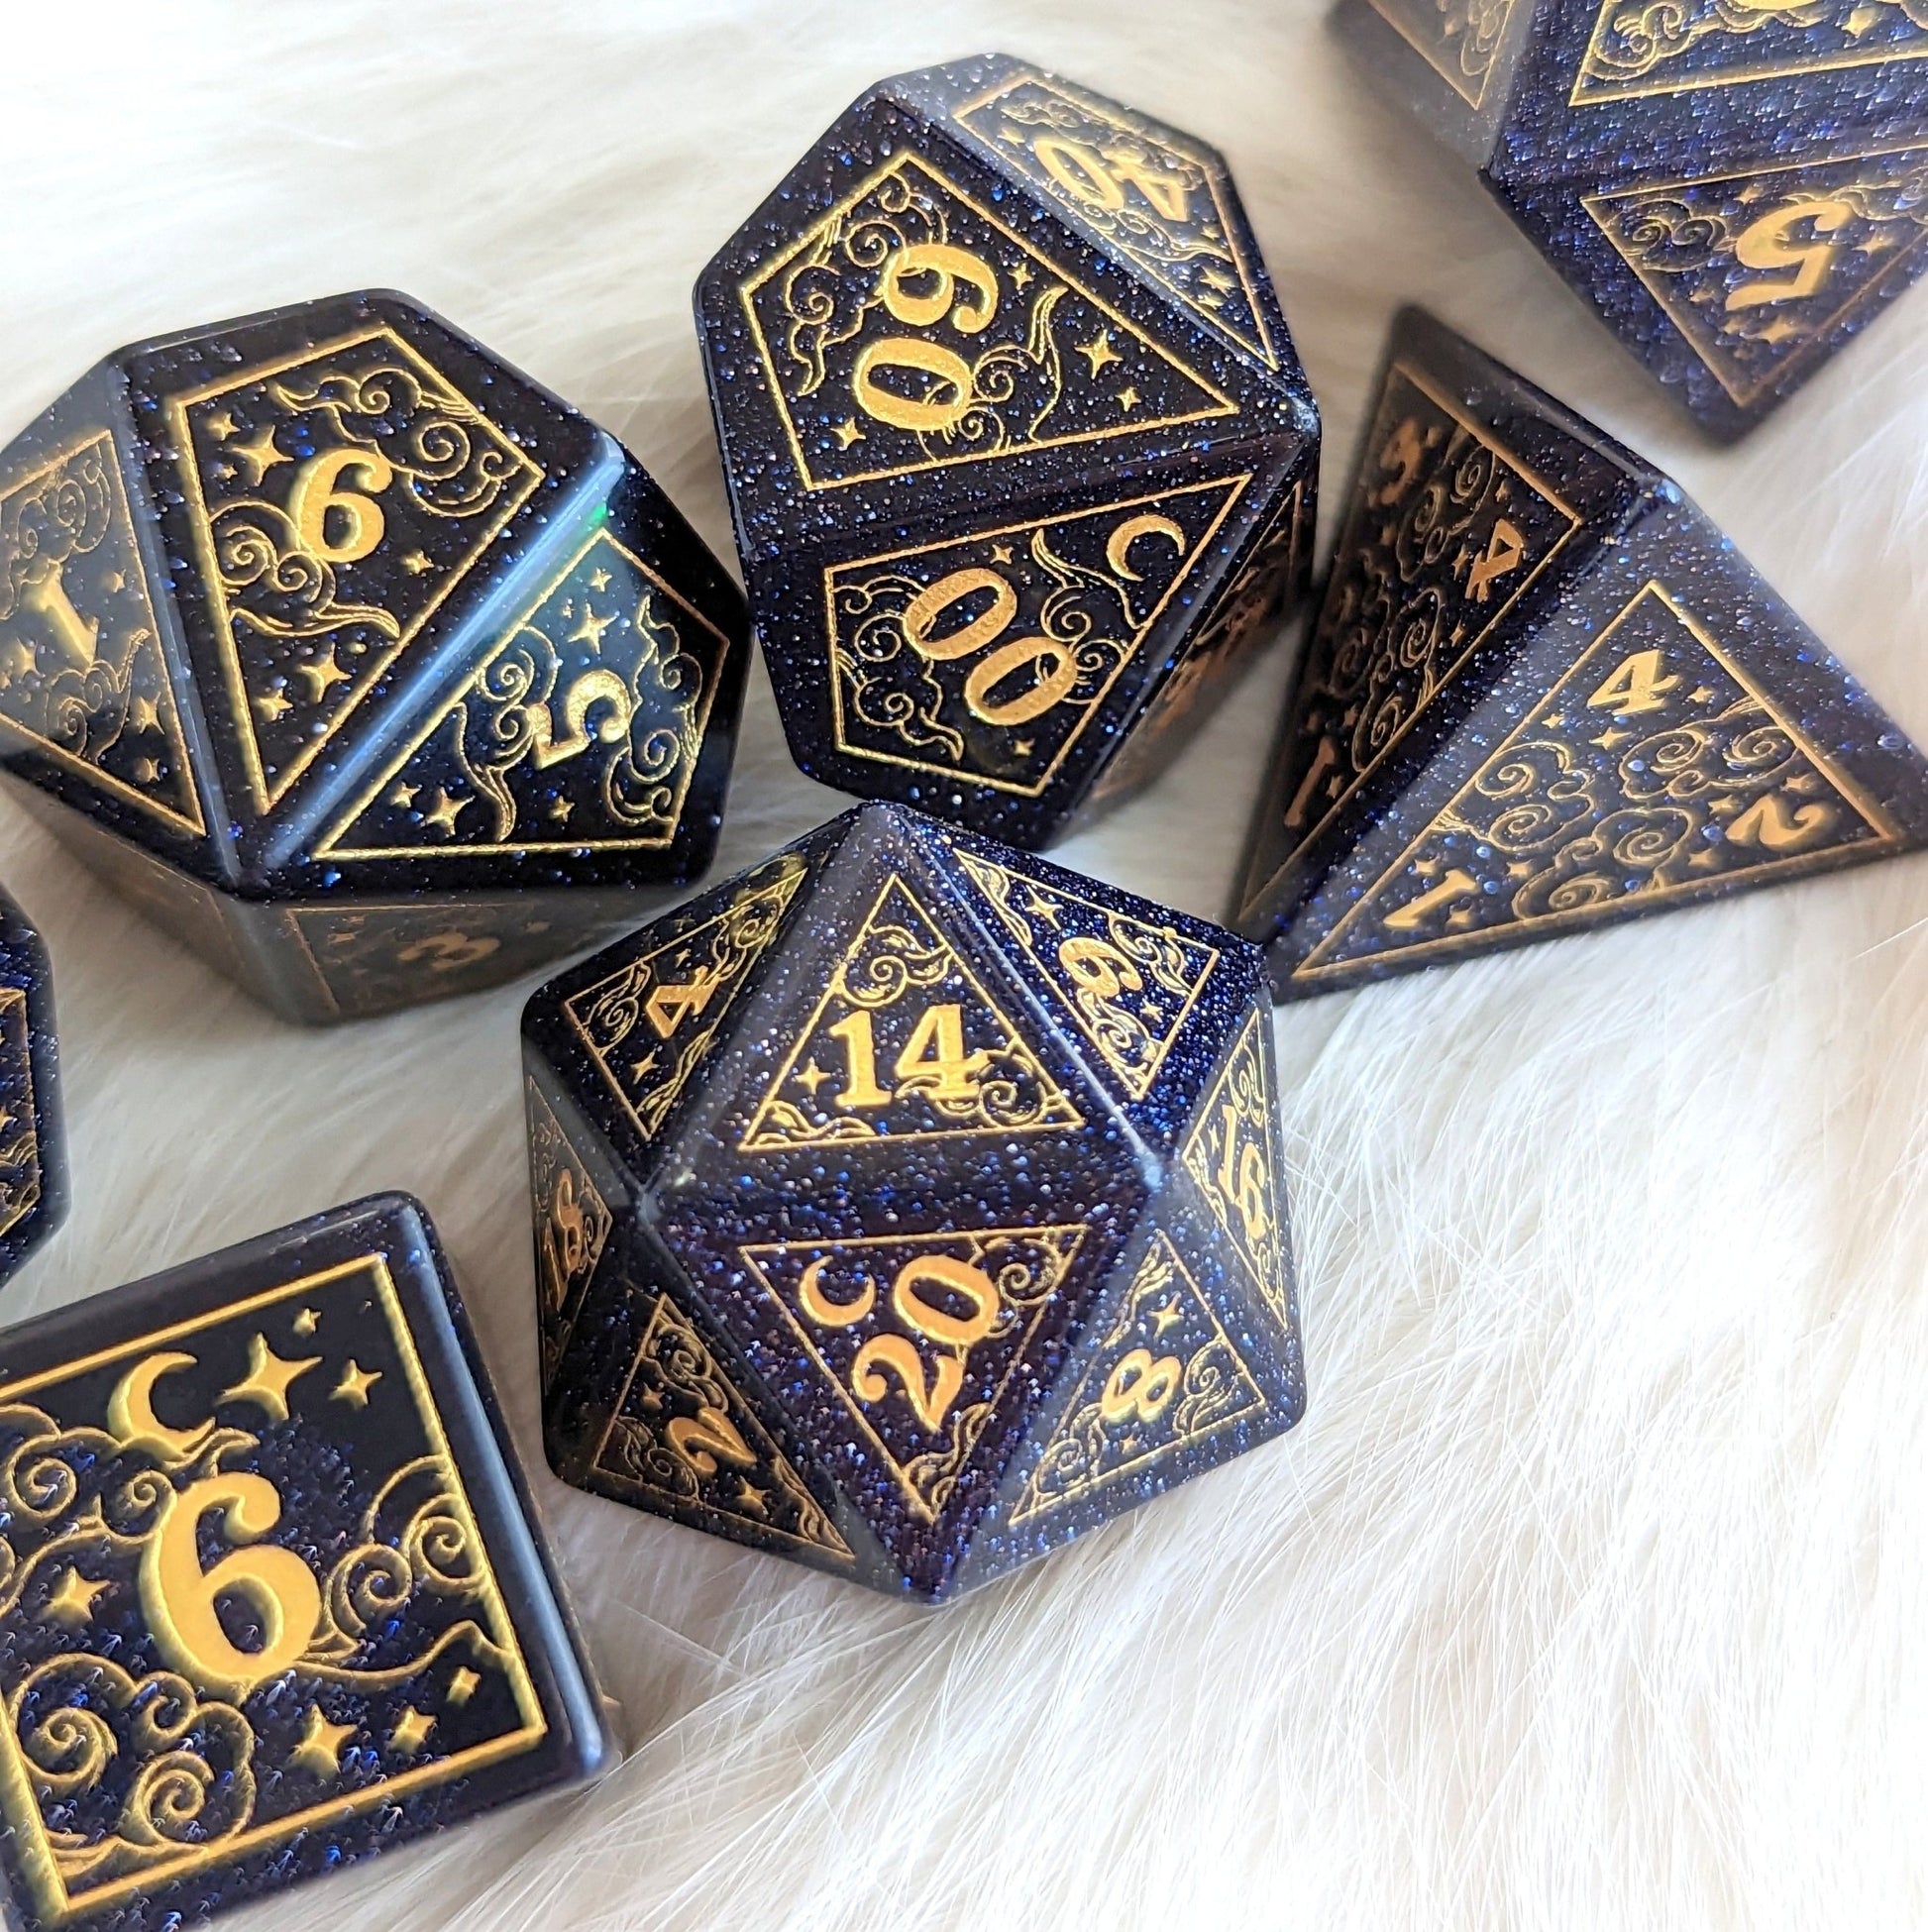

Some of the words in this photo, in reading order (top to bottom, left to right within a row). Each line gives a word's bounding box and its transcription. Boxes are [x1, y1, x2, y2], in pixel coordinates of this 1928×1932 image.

[1725, 200, 1851, 311] 5
[1465, 518, 1524, 602] 4
[38, 560, 99, 665] 1
[904, 569, 1077, 725] 00
[530, 671, 631, 769] 5
[1588, 649, 1681, 715] 4
[1726, 795, 1828, 848] 2
[1383, 870, 1476, 928] 1
[646, 966, 716, 1039] 4
[828, 1003, 991, 1109] 14
[851, 1254, 997, 1434] 20
[1102, 1348, 1183, 1424] 8
[668, 1407, 757, 1472] 2
[142, 1472, 321, 1686] 6
